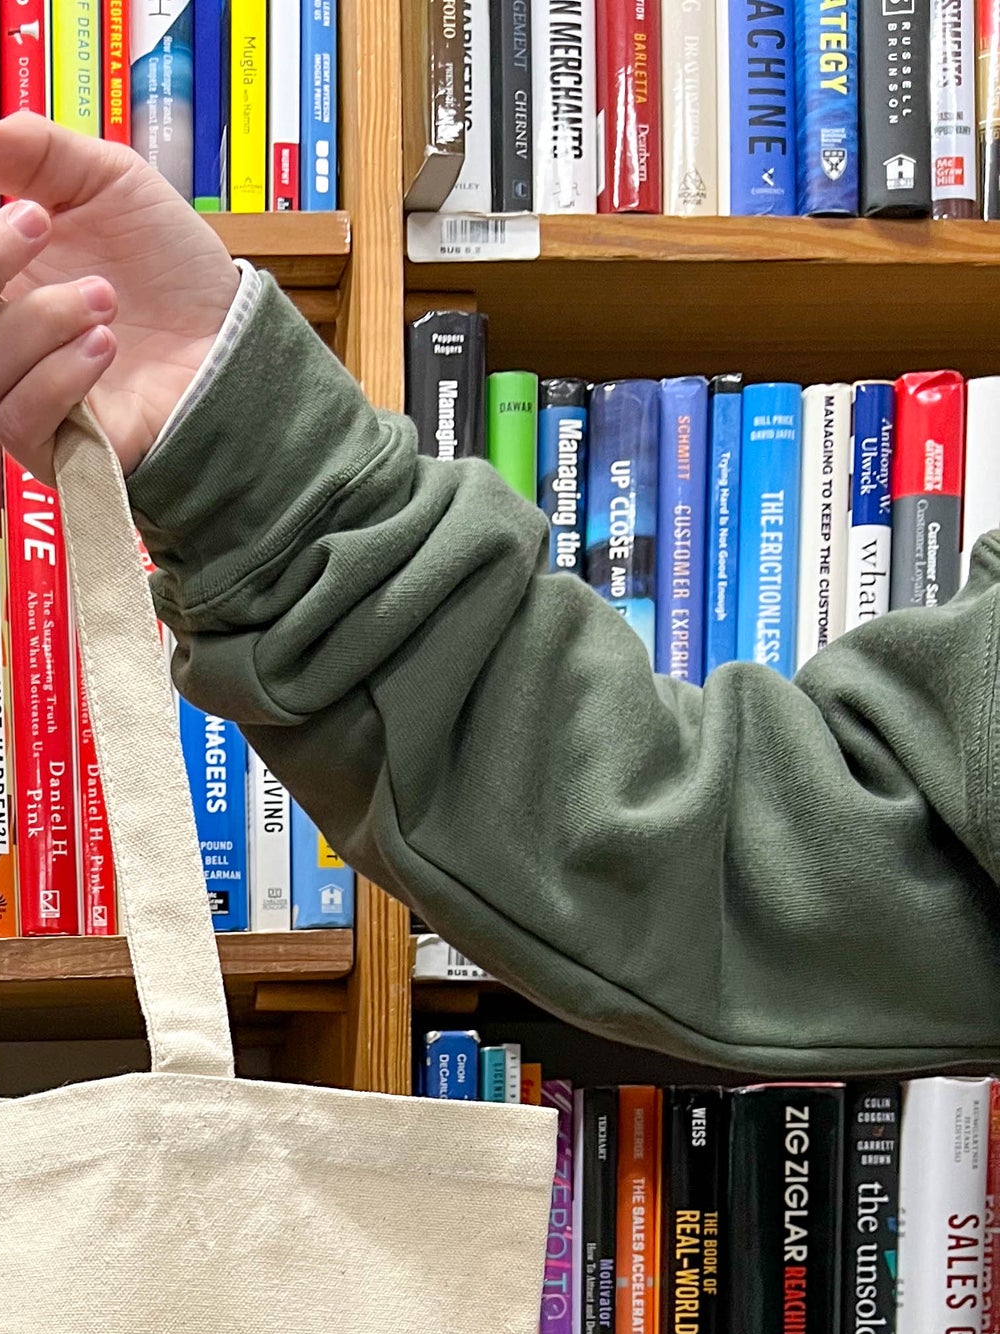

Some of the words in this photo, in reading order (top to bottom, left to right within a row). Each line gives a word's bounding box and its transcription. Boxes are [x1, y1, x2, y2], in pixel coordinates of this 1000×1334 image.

[888, 23, 899, 124] BRUNSON
[902, 22, 911, 116] RUSSELL
[514, 90, 527, 159] CHERNEV
[499, 402, 533, 413] DAWAR
[552, 419, 583, 528] Managing
[556, 532, 582, 568] the
[27, 788, 44, 838] Pink
[692, 1107, 706, 1147] WEISS
[785, 1106, 810, 1155] ZIG
[704, 1211, 718, 1237] THE
[784, 1161, 809, 1263] ZIGLAR
[857, 1181, 889, 1234] the
[703, 1240, 718, 1274] BOOK
[946, 1213, 980, 1310] SALES
[703, 1279, 717, 1295] OF
